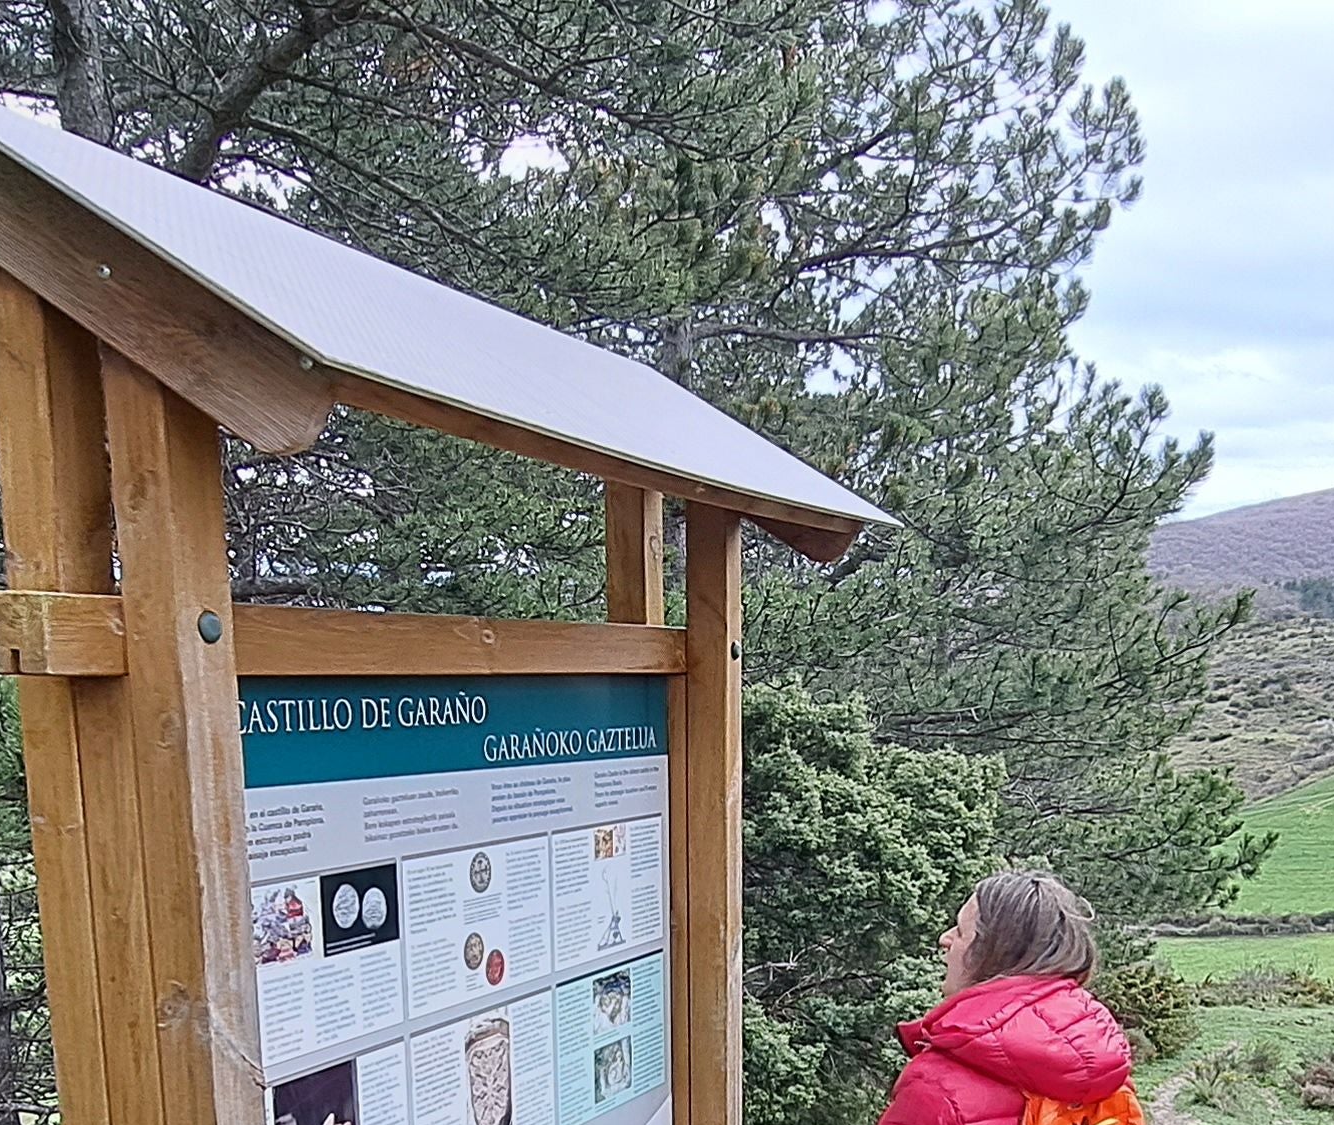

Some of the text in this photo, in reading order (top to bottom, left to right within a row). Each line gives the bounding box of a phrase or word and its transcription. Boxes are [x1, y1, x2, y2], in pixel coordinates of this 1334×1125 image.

[361, 698, 392, 729] DE
[398, 691, 487, 727] GARAÑO
[483, 726, 657, 762] GARAÑOKO GAZTELUA
